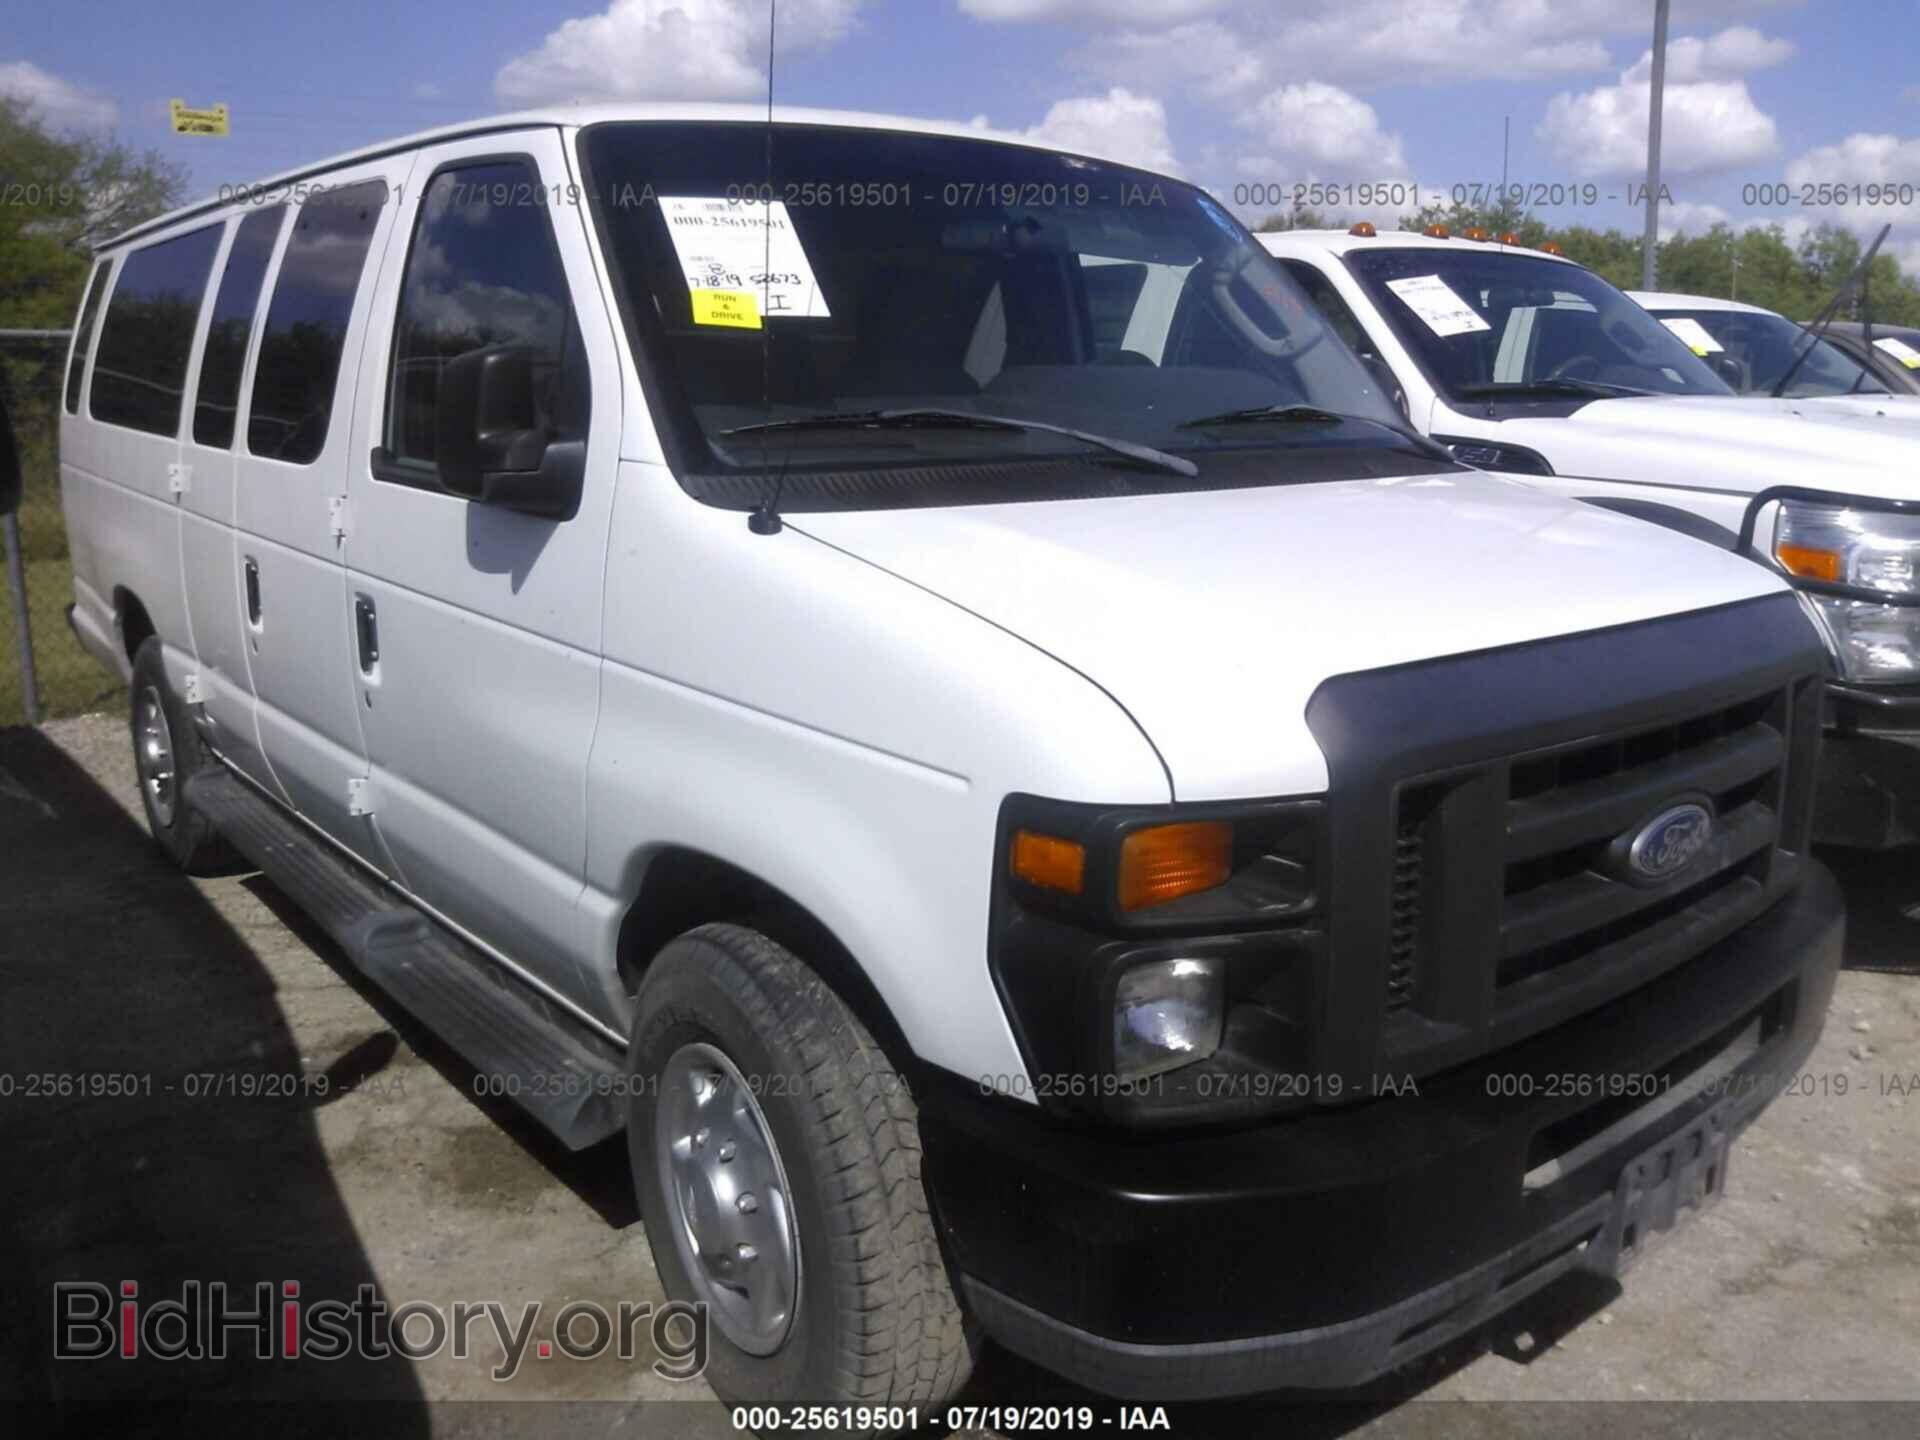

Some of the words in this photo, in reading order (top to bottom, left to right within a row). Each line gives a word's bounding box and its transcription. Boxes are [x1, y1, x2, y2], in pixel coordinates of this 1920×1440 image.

[673, 216, 785, 229] 000-25619501
[713, 293, 736, 302] RUN
[711, 311, 743, 321] DRIVE
